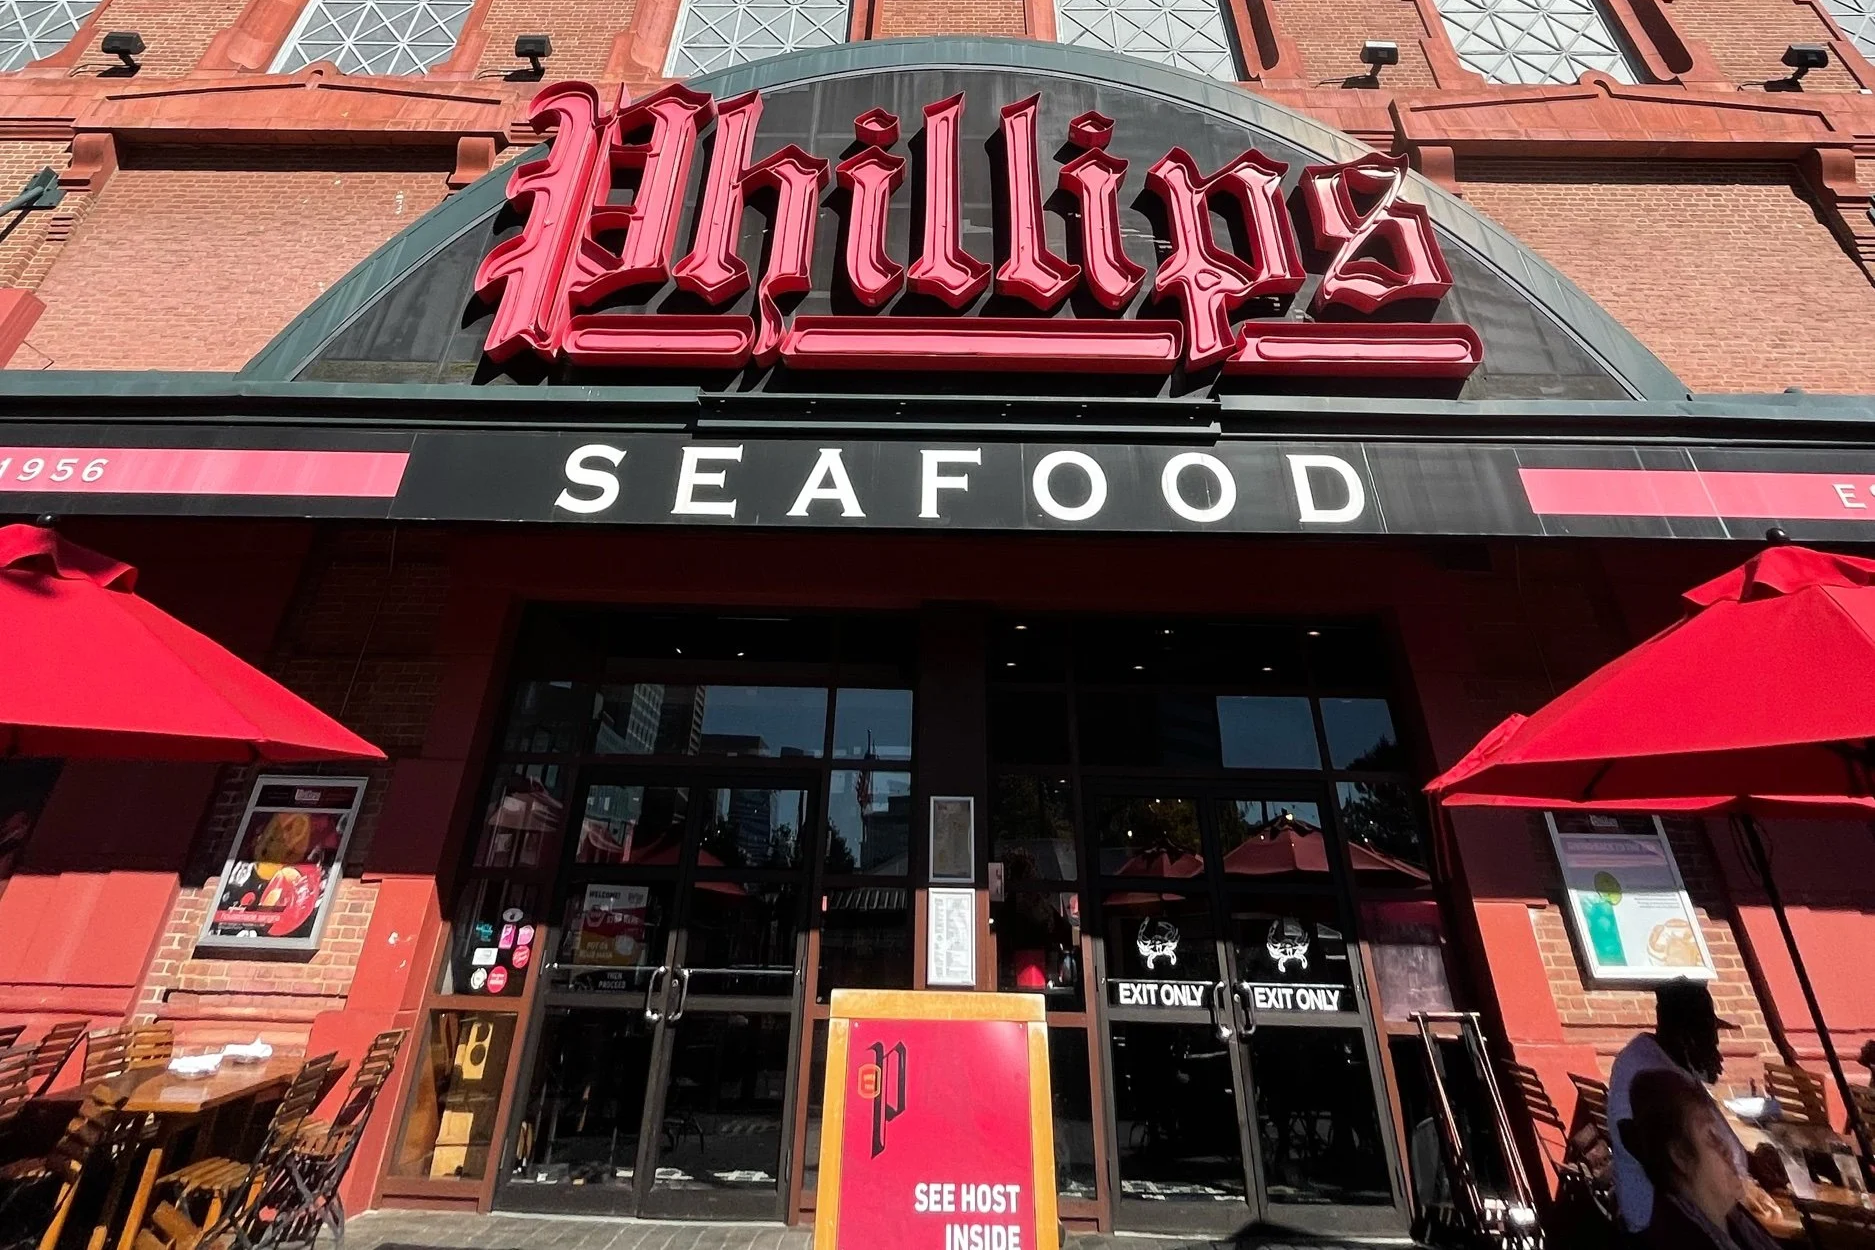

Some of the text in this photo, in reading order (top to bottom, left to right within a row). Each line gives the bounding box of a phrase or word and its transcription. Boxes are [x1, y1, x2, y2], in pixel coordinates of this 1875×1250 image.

[475, 81, 1481, 372] Phillips
[0, 457, 109, 482] 1956
[554, 444, 1366, 524] SEAFOOD
[1832, 483, 1875, 509] E
[1118, 983, 1204, 1006] EXIT ONLY
[1254, 987, 1340, 1011] EXIT ONLY
[914, 1182, 1021, 1214] SEE HOST
[945, 1223, 1022, 1250] INSIDE
